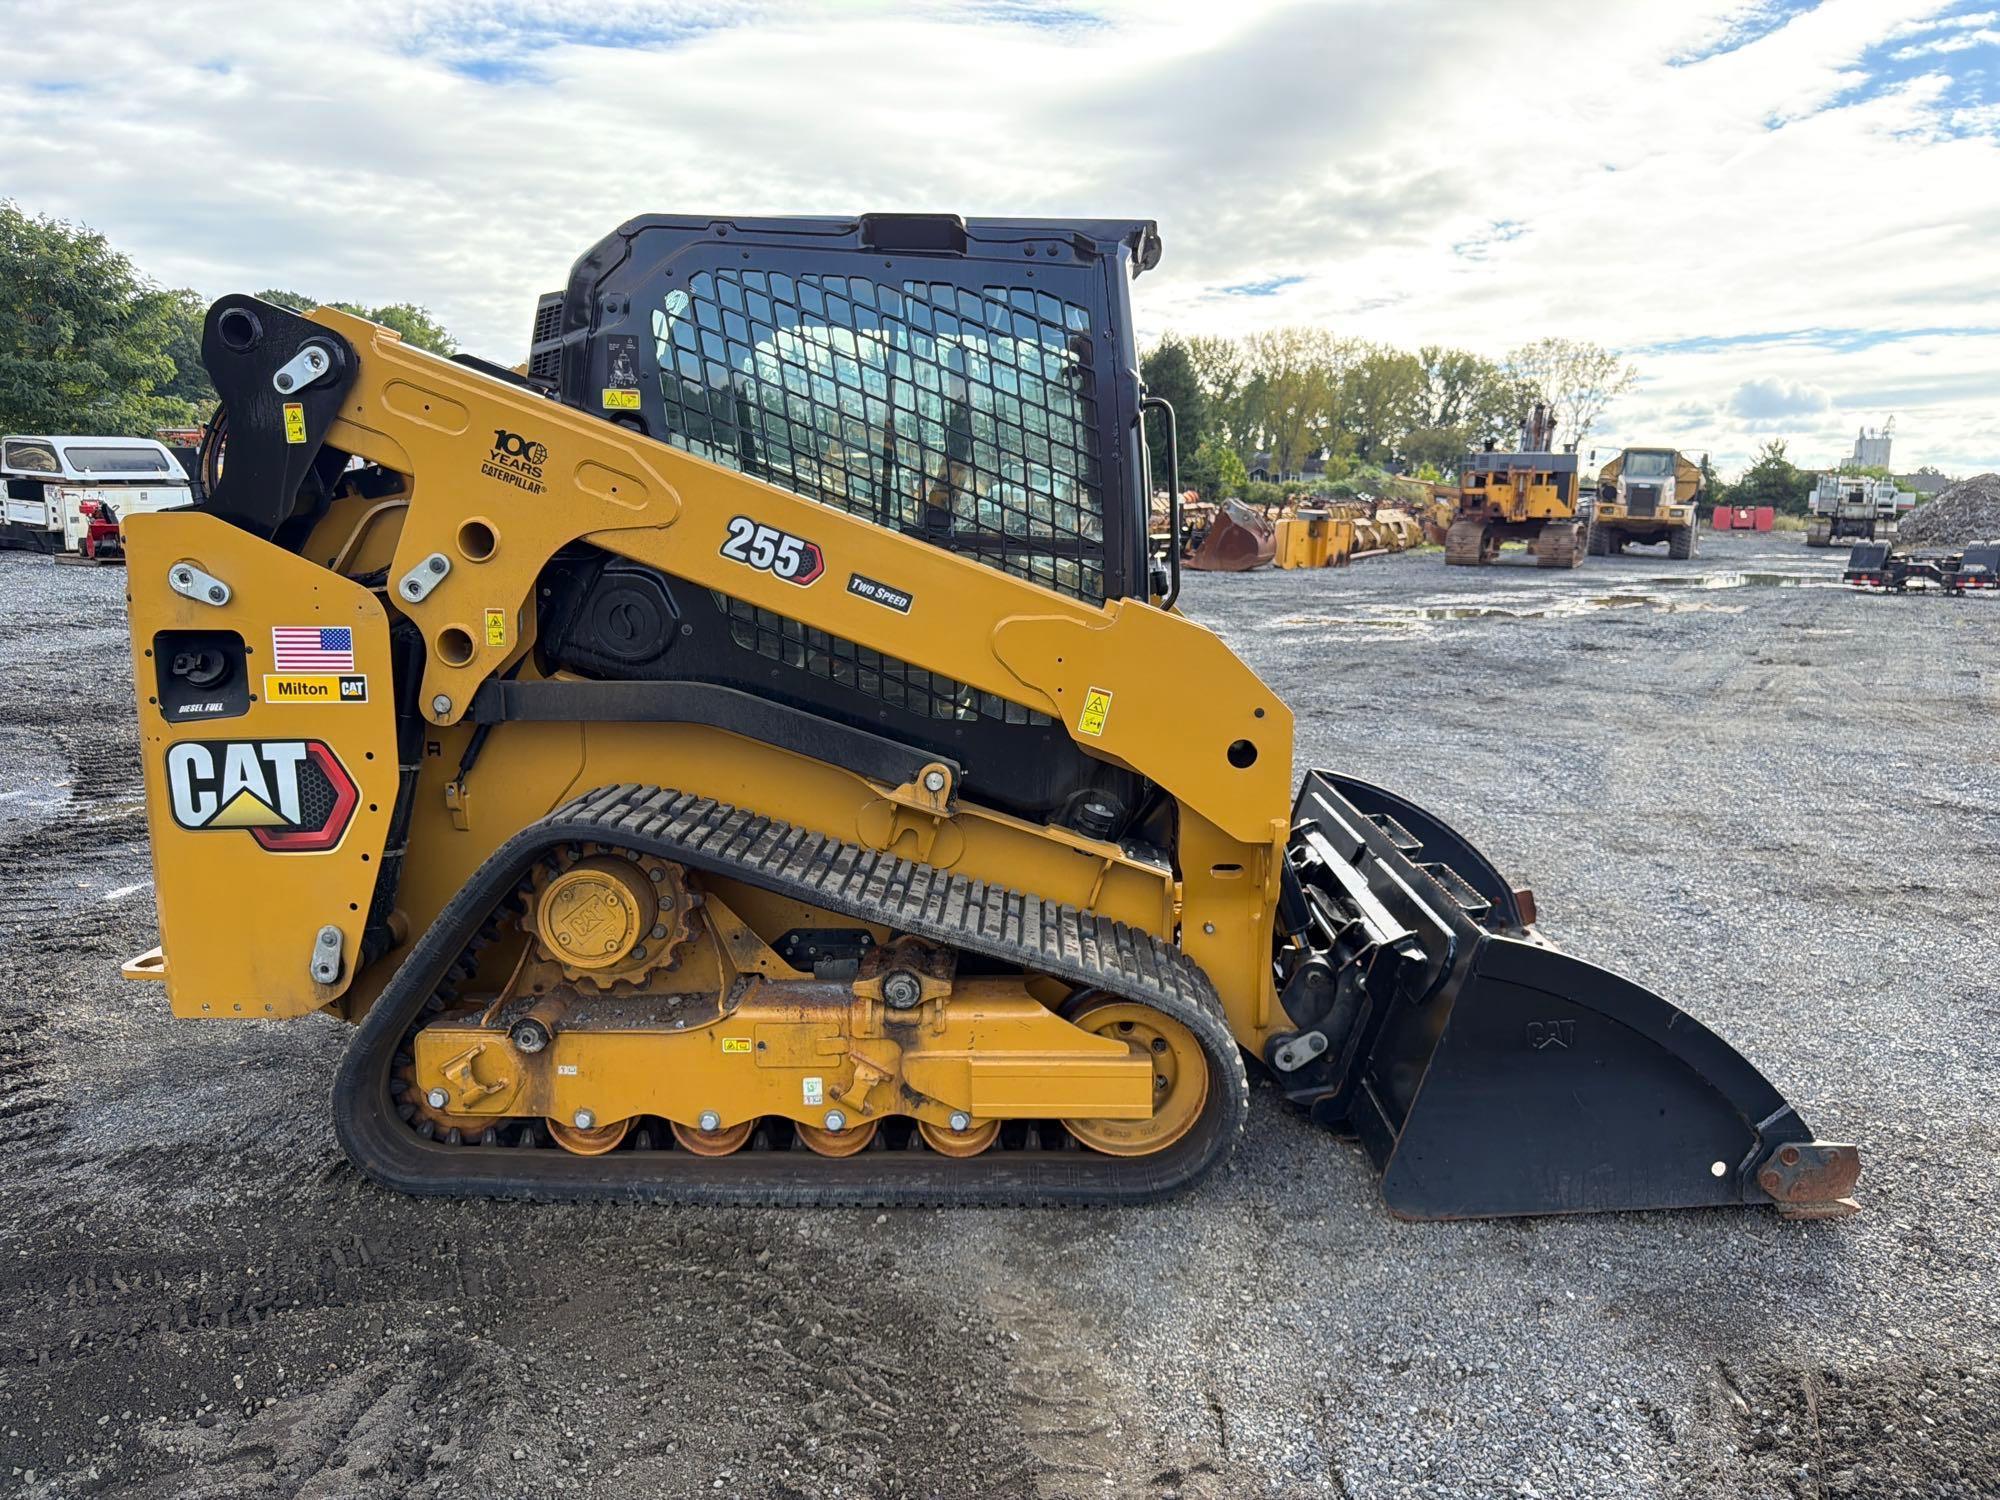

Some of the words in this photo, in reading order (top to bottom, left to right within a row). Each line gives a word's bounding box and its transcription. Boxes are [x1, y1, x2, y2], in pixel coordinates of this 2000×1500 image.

[494, 429, 548, 465] 100
[490, 449, 543, 478] YEARS
[722, 516, 805, 577] 255
[852, 578, 875, 595] TWO
[875, 588, 908, 607] SPEED
[278, 682, 328, 695] Milton
[341, 681, 363, 696] CAT
[178, 704, 203, 713] DIESEL
[205, 703, 224, 711] FUEL
[168, 742, 306, 827] CAT
[570, 903, 604, 936] CAT
[1526, 1019, 1576, 1049] CAT
